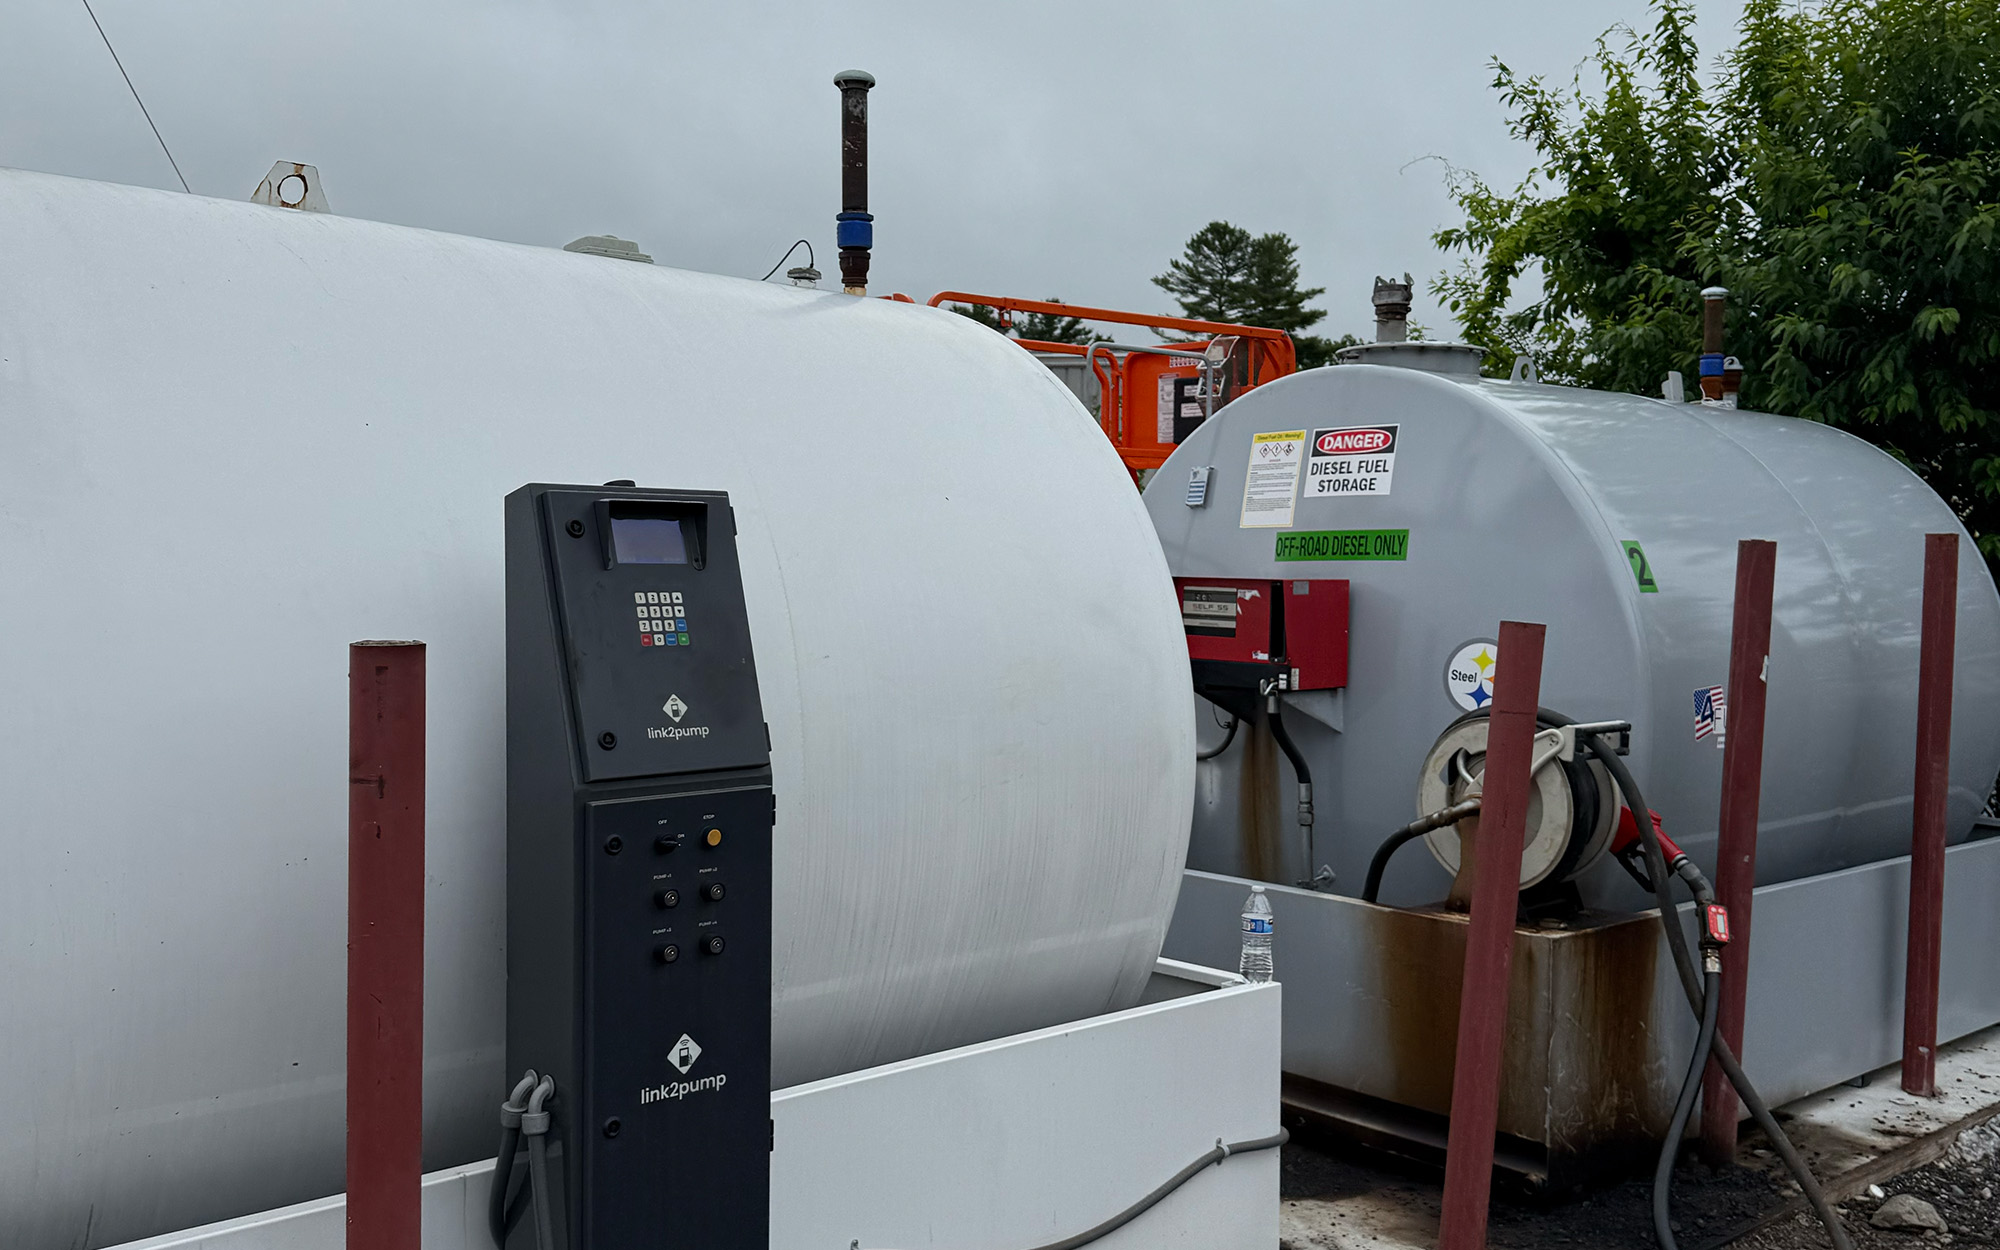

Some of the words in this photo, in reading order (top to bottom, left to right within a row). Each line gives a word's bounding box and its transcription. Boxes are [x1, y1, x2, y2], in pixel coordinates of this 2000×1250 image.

[1323, 433, 1384, 450] DANGER
[1310, 460, 1353, 476] DIESEL
[1357, 459, 1390, 474] FUEL
[1317, 477, 1377, 493] STORAGE
[1276, 536, 1329, 558] OFF-ROAD
[1331, 535, 1371, 557] DIESEL
[1373, 534, 1406, 556] ONLY
[1628, 547, 1654, 586] 2
[1450, 669, 1478, 683] Steel
[1701, 695, 1714, 723] 4
[647, 725, 710, 740] link2pump
[640, 1072, 727, 1104] link2pump
